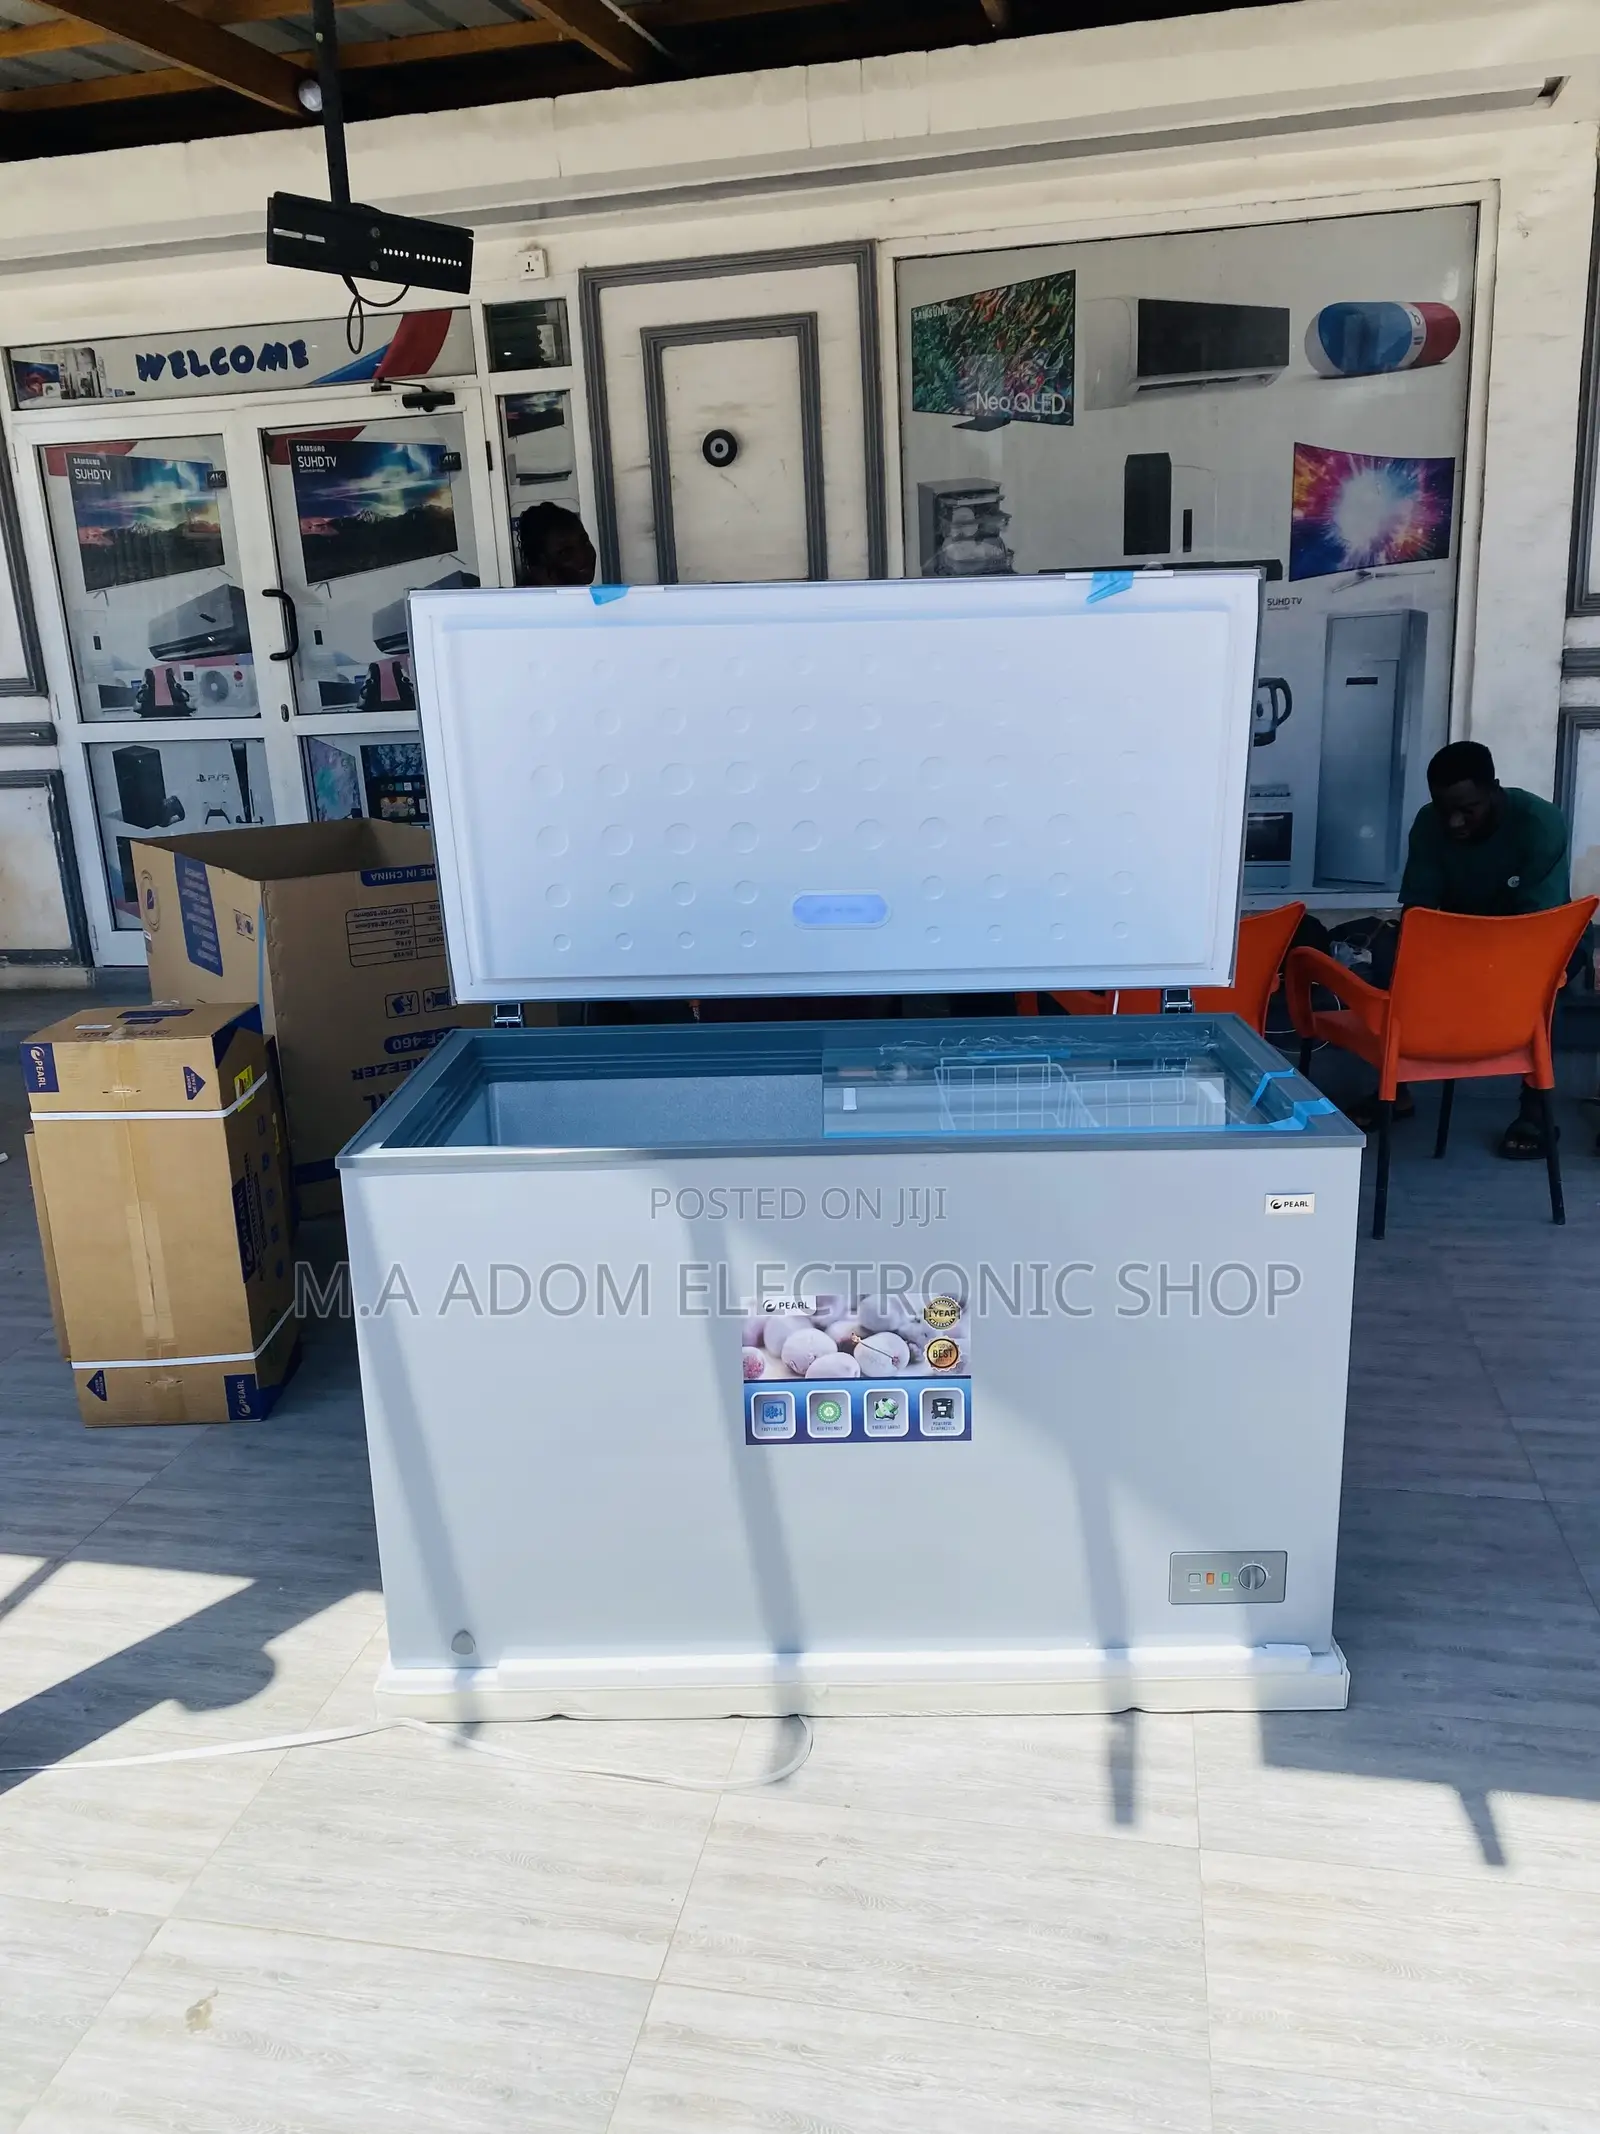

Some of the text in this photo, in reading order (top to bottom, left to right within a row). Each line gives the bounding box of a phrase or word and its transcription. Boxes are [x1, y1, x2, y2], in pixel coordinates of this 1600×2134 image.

[913, 305, 948, 321] SAMSUNG
[135, 339, 309, 382] WELCOME
[976, 391, 1066, 415] Neo QLED
[73, 457, 101, 466] SAMSUNG
[370, 870, 404, 881] CHINA
[406, 869, 417, 878] IN
[35, 1060, 46, 1088] PEARL
[778, 1301, 810, 1310] PEARL
[933, 1309, 957, 1317] YEAR
[932, 1349, 953, 1358] BEST
[239, 1379, 249, 1404] PEARL
